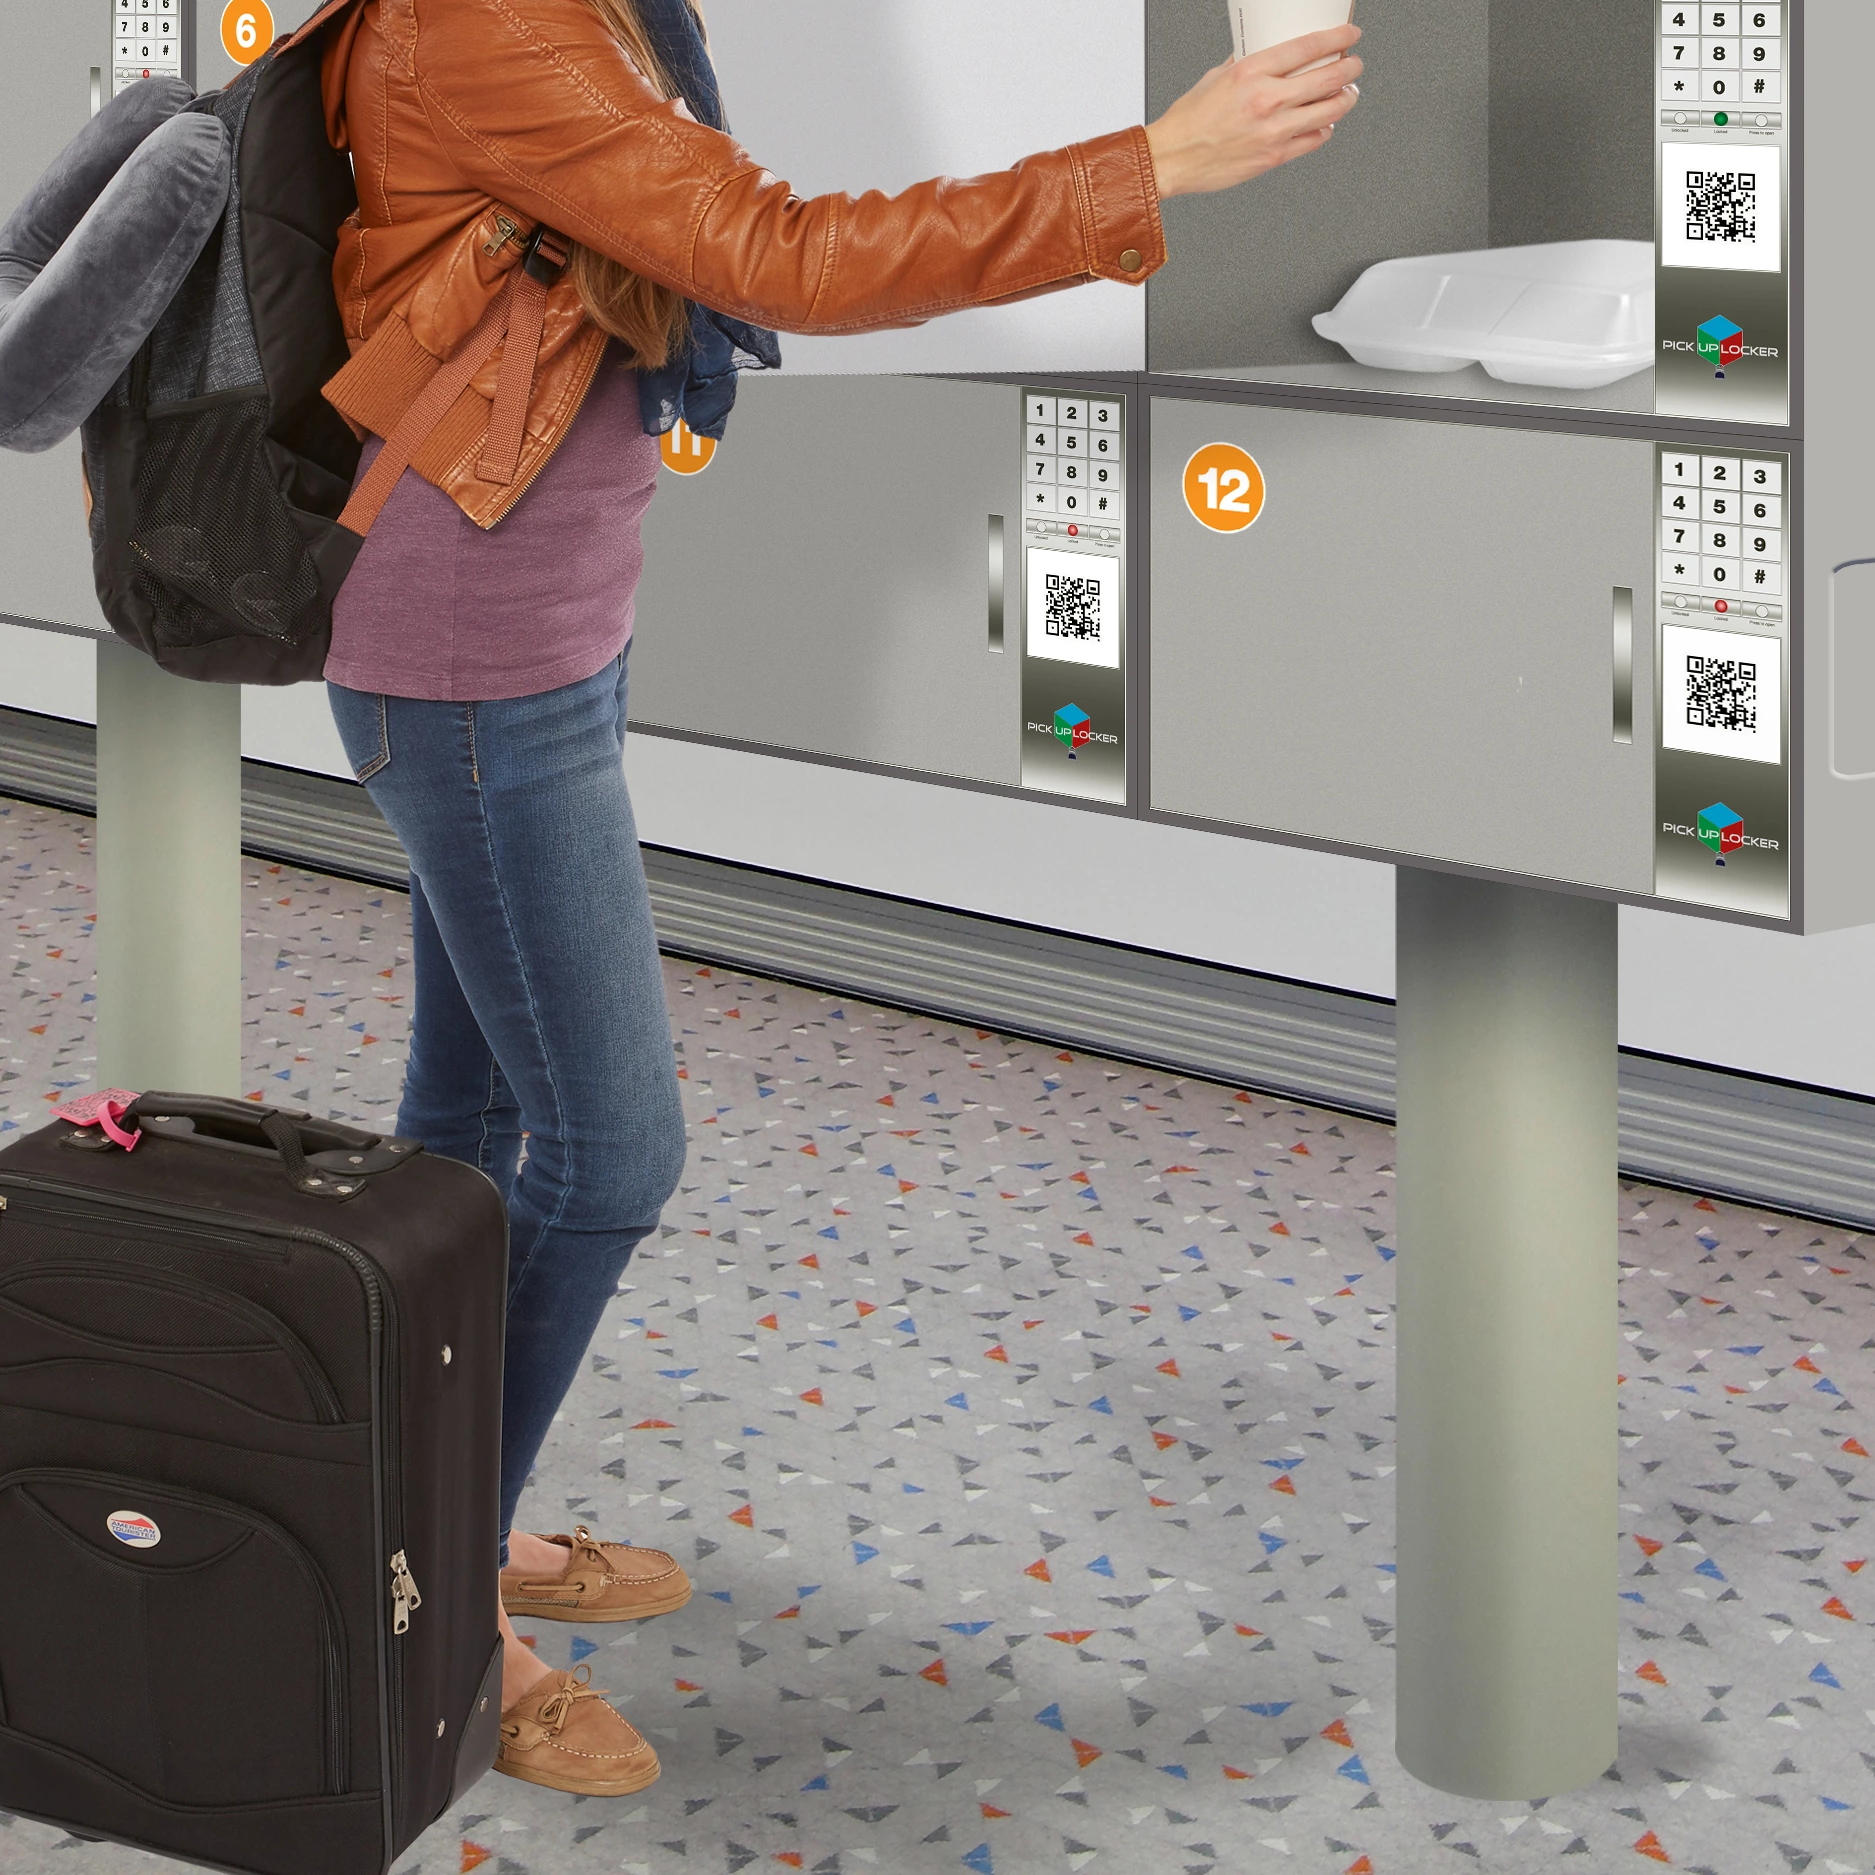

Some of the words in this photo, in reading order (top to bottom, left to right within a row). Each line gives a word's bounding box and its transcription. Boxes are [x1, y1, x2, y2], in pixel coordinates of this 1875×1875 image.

[237, 14, 256, 47] 6
[1199, 468, 1249, 512] 12
[111, 1521, 156, 1534] AMERICAN
[112, 1526, 156, 1538] TOURISTER
